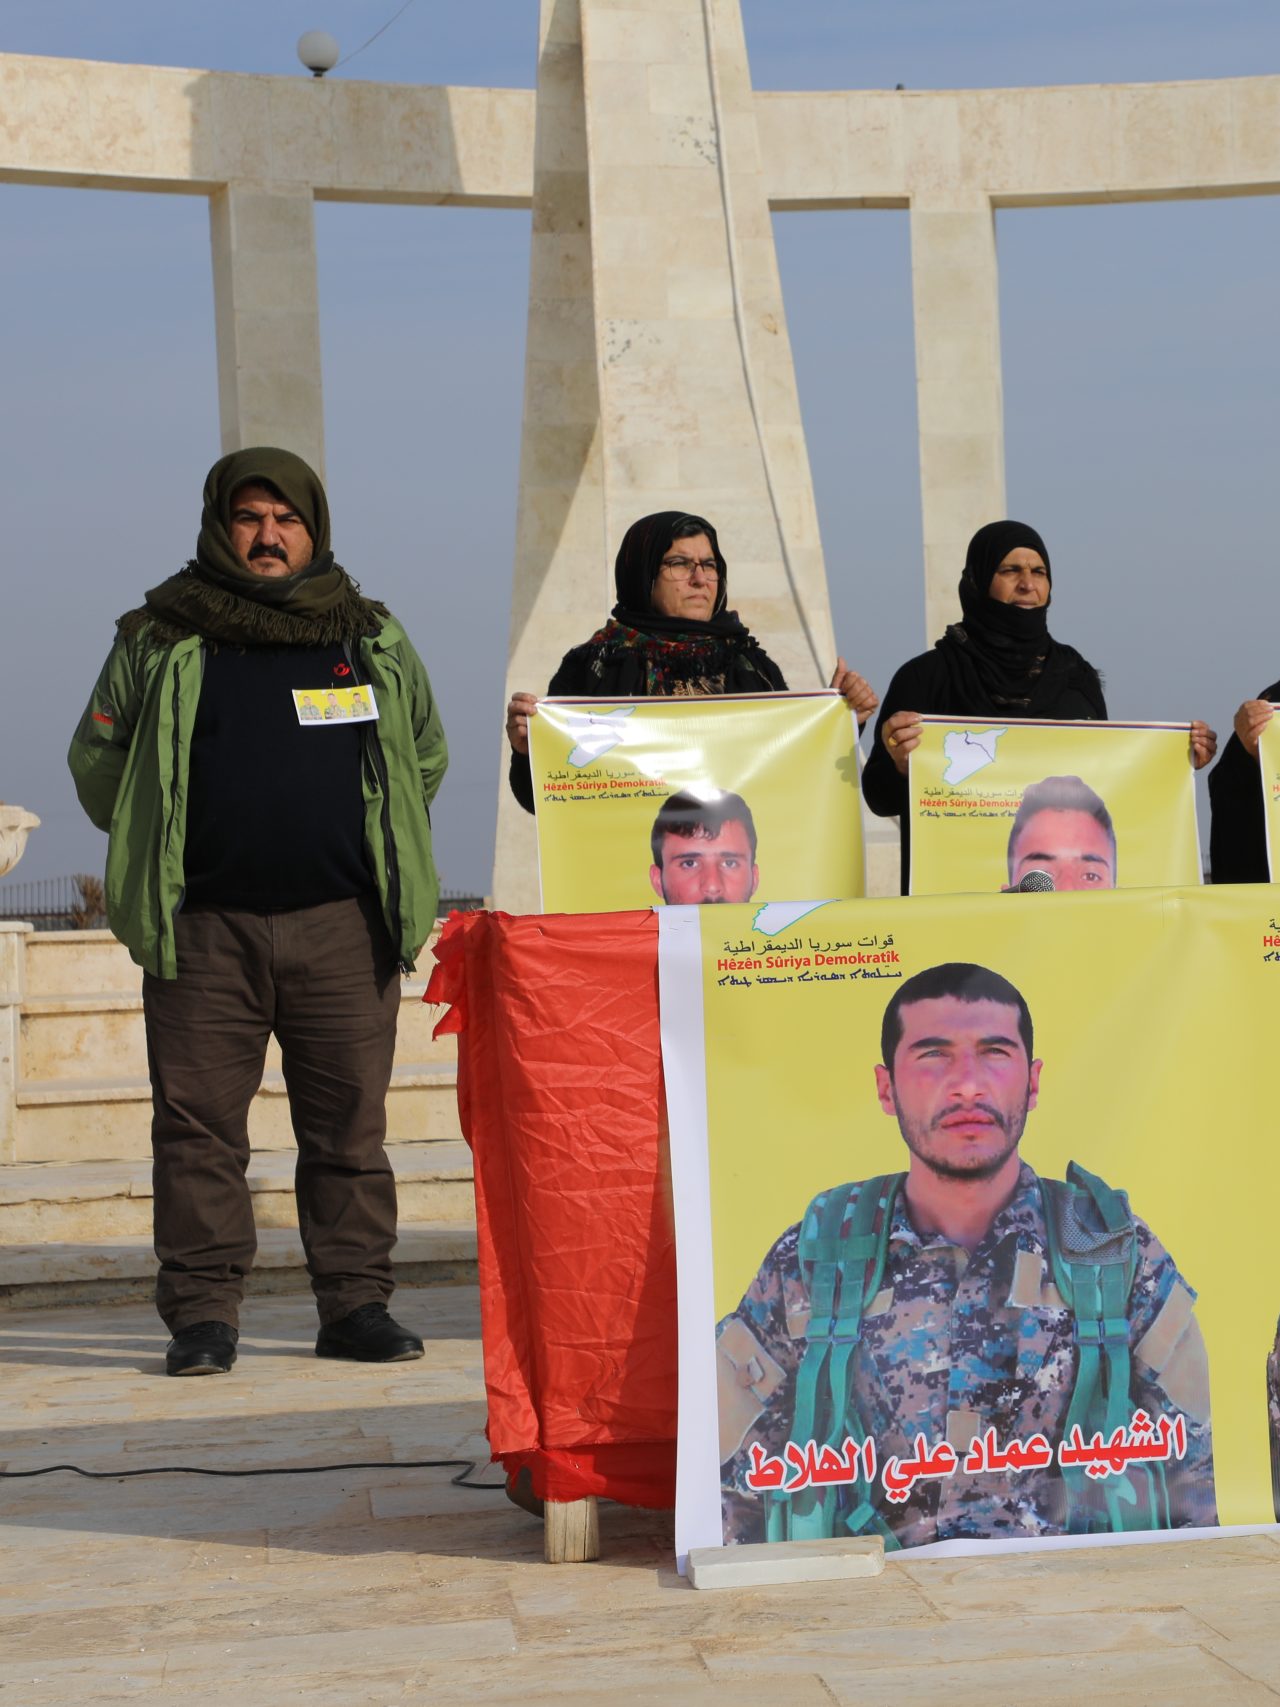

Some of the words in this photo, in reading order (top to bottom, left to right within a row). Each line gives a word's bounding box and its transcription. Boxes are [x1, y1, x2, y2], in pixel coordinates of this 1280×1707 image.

[543, 781, 574, 791] Hêzên
[576, 780, 608, 791] Sûriya
[920, 798, 947, 807] Hêzên
[949, 798, 977, 808] Sûriya
[723, 937, 803, 956] الديمقراطية
[808, 937, 852, 952] سوريا
[857, 934, 894, 950] قوات
[717, 957, 763, 971] Hêzên
[766, 953, 811, 970] Sûriya
[814, 950, 900, 966] Demokratîk
[962, 1427, 1052, 1474] عماد
[1059, 1410, 1187, 1479] الشهيد
[746, 1435, 876, 1491] الهلاط
[883, 1433, 956, 1503] علي
